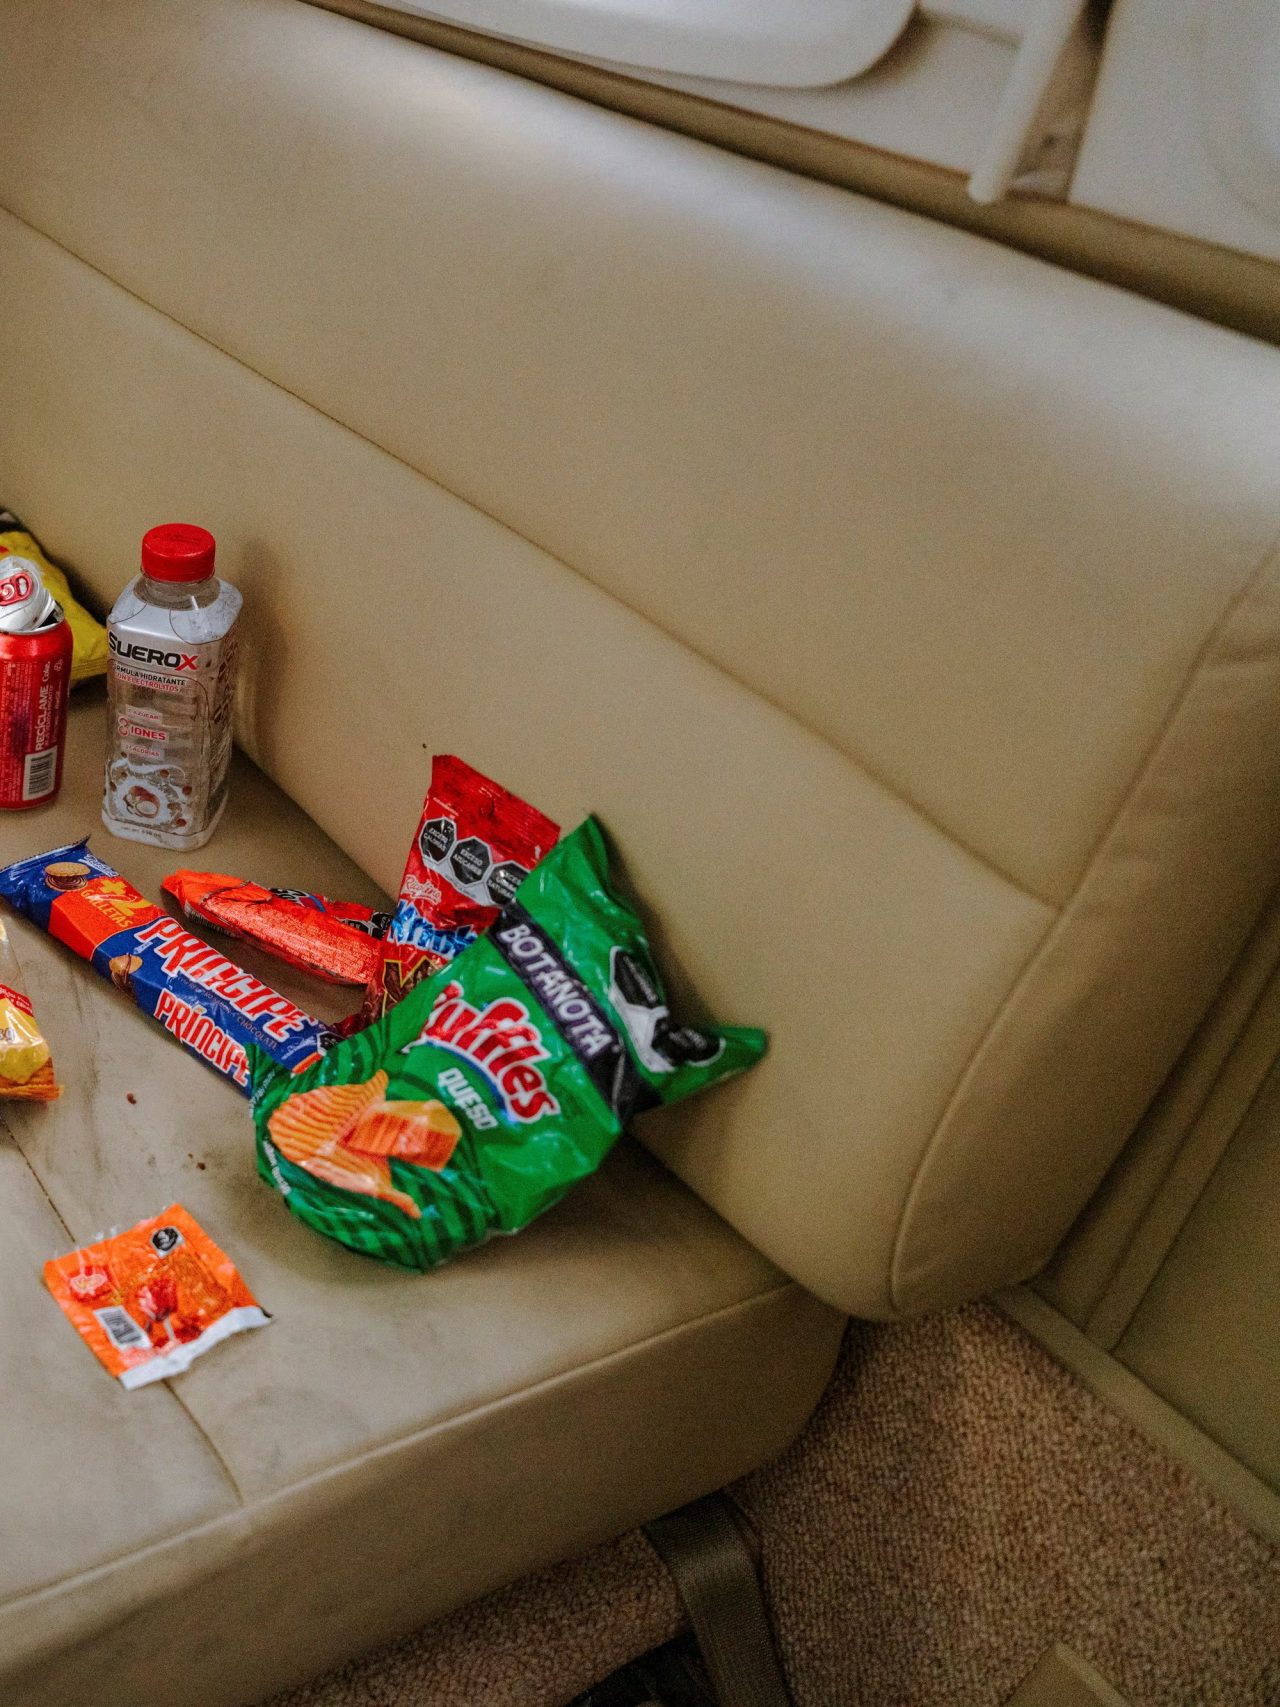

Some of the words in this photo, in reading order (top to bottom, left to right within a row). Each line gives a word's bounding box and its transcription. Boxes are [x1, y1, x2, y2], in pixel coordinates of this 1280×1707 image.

[108, 631, 199, 671] SUEROX
[140, 673, 186, 687] HIDRATANTE
[131, 725, 166, 740] IONES
[460, 849, 483, 866] EXCESO
[500, 924, 613, 1057] BOTANOTA
[237, 1016, 278, 1050] CHOCOLATE
[438, 1068, 498, 1130] QUESO
